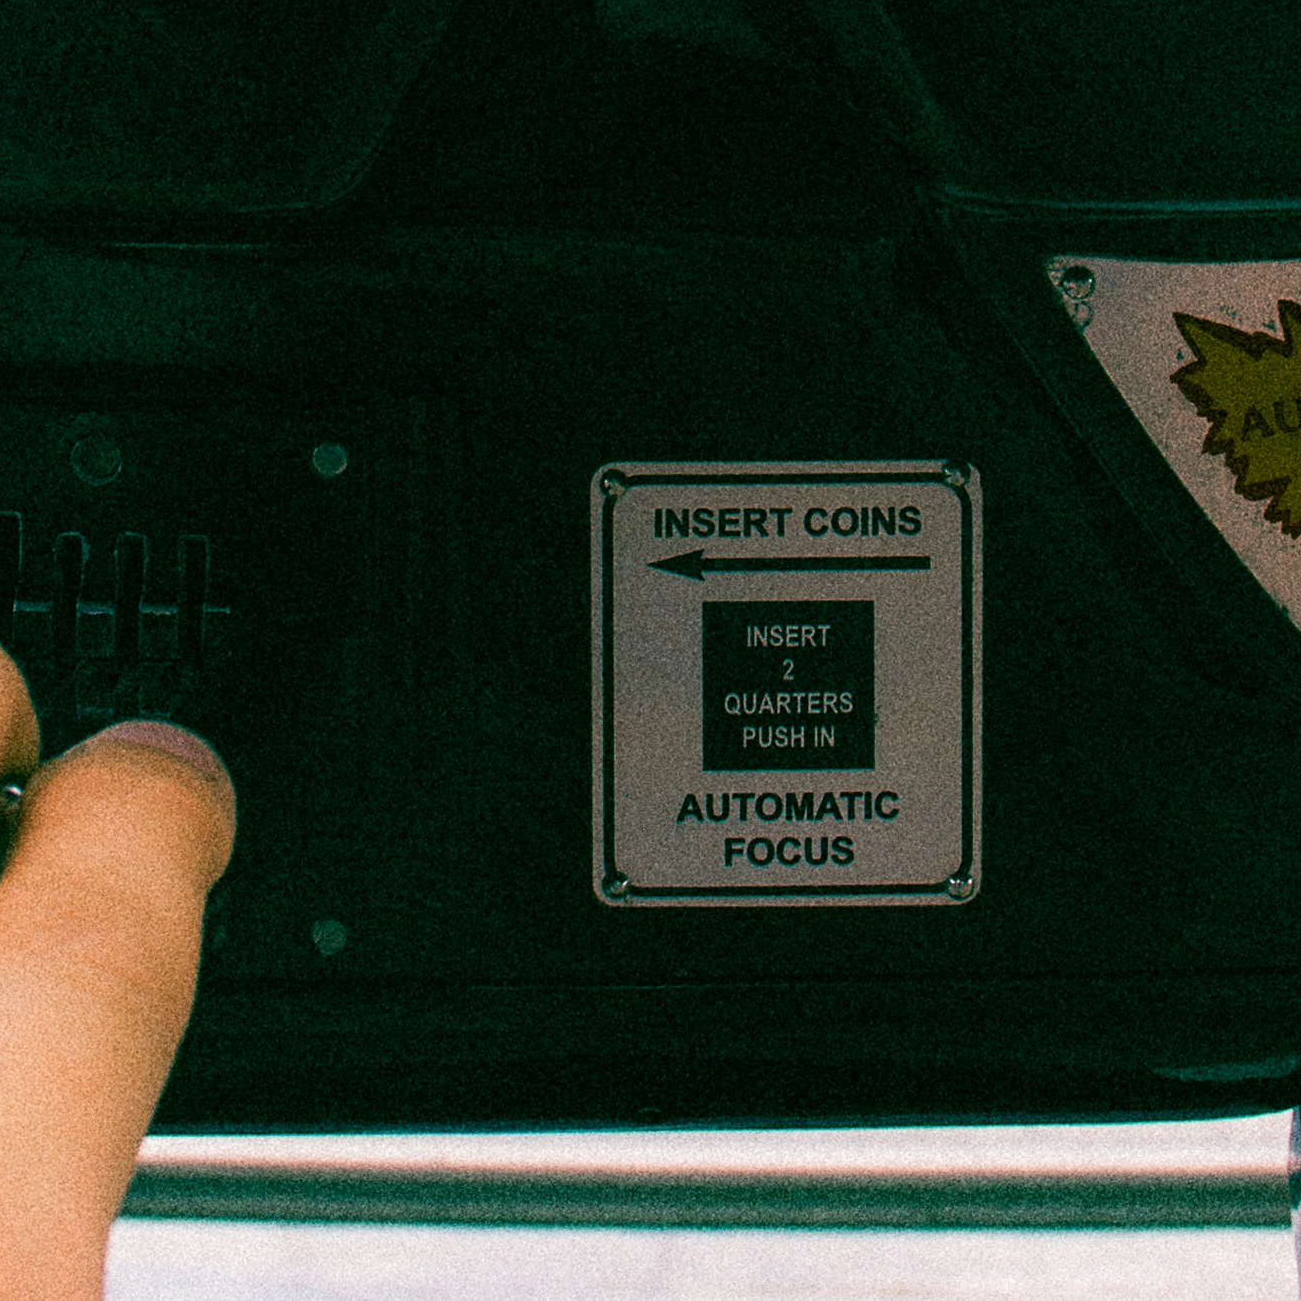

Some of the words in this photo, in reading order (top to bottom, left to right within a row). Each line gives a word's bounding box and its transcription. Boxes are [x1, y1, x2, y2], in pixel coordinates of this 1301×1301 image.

[653, 507, 793, 539] INSERT
[803, 506, 923, 537] COINS
[746, 625, 831, 647] INSERT
[782, 659, 795, 681] 2
[724, 693, 854, 715] QUARTERS
[743, 726, 805, 748] PUSH
[814, 725, 835, 748] IN
[676, 792, 901, 824] AUTOMATIC
[724, 836, 855, 867] FOCUS
